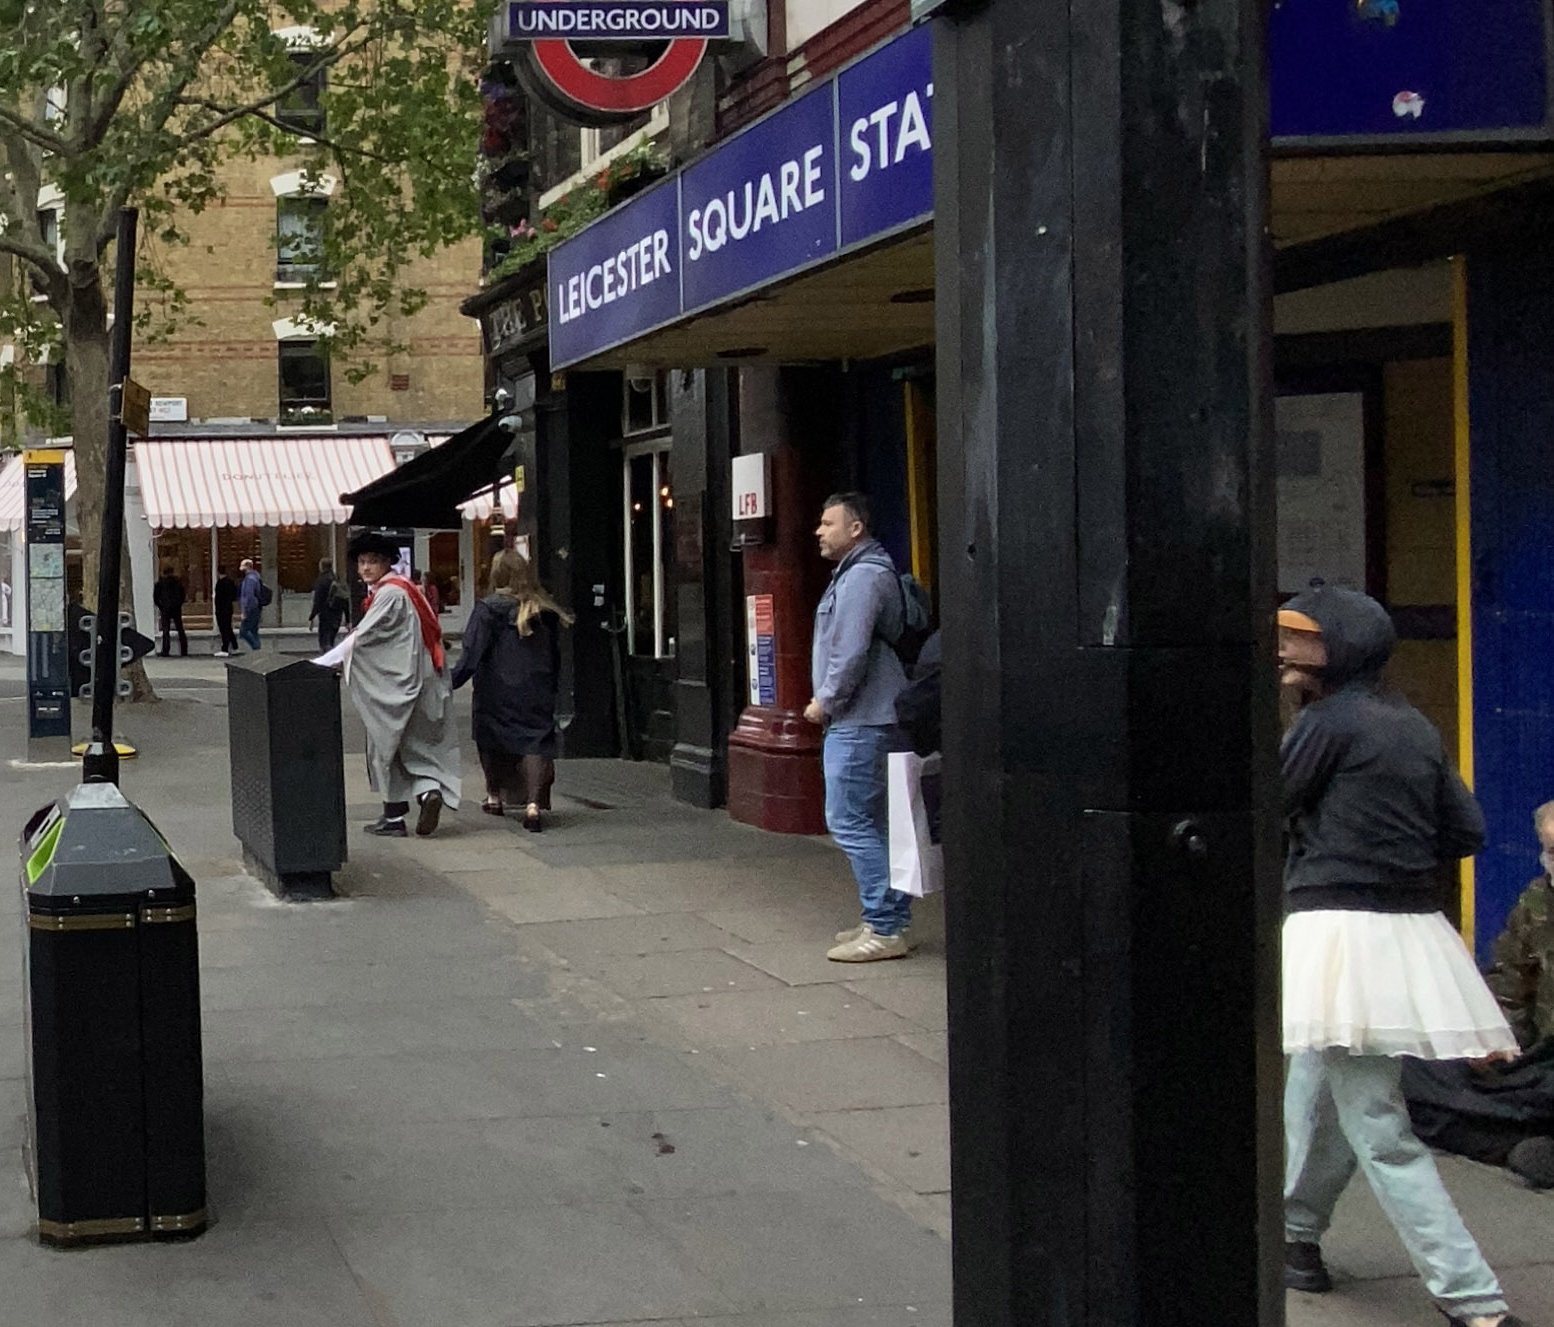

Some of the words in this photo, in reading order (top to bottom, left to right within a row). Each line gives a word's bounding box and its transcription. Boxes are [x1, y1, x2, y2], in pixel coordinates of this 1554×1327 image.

[517, 7, 721, 32] UNDERGROUND
[558, 228, 672, 325] LEICESTER
[688, 144, 825, 262] SQUARE
[850, 82, 935, 183] STA
[738, 492, 758, 516] LFB
